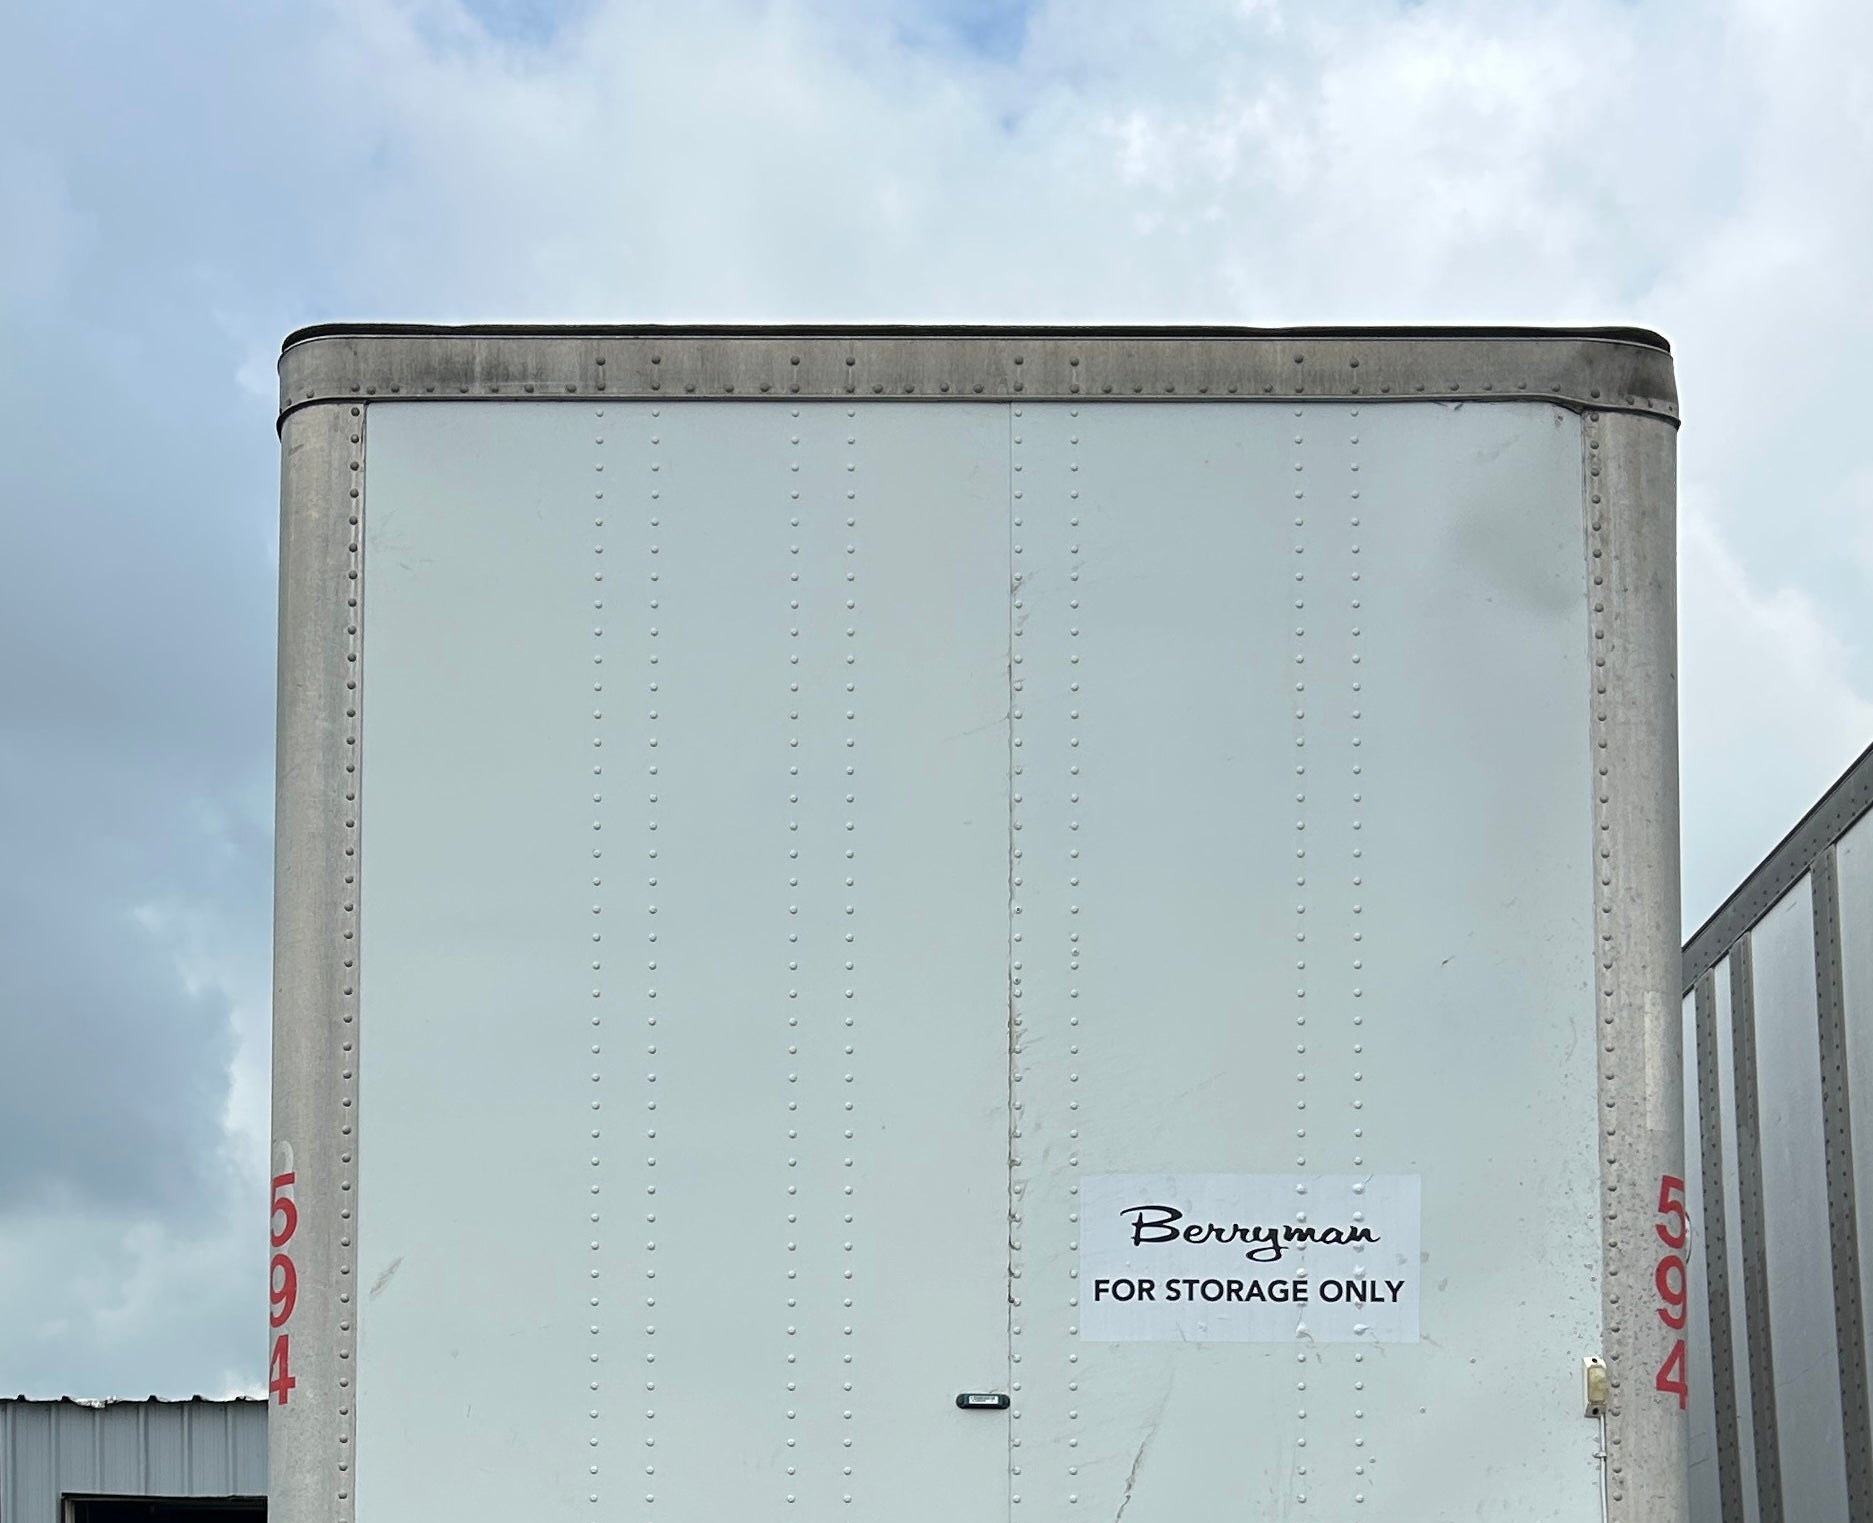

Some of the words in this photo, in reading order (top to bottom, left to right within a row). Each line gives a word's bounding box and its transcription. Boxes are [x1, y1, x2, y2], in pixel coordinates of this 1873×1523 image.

[270, 1172, 298, 1405] 594
[1094, 1279, 1156, 1302] FOR
[1165, 1279, 1309, 1303] STORAGE
[1319, 1279, 1405, 1303] ONLY
[1119, 1205, 1381, 1262] Berryman
[1655, 1175, 1688, 1411] 594
